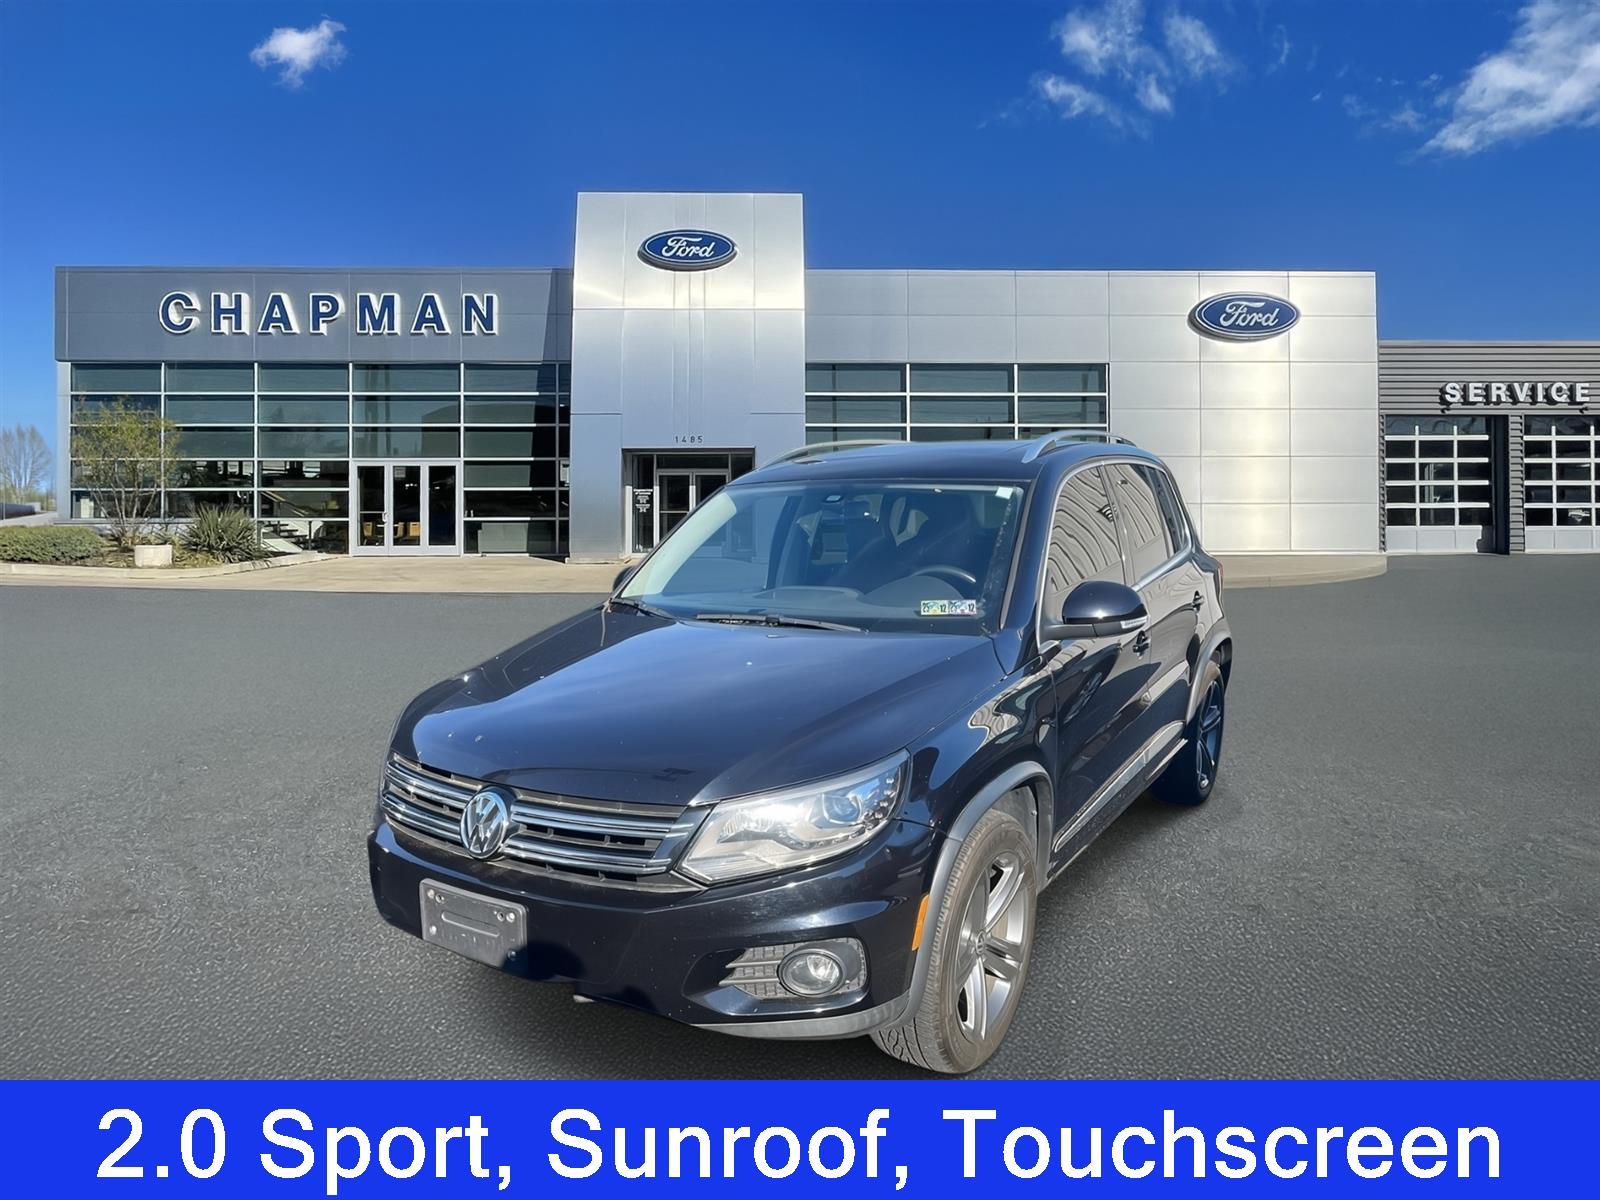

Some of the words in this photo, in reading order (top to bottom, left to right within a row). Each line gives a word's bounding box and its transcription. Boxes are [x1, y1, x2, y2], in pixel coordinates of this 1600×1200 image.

[660, 236, 715, 258] Ford
[158, 291, 498, 335] CHAPMAN
[1219, 301, 1280, 327] Ford
[1443, 381, 1591, 403] SERVICE
[675, 435, 703, 444] 1485
